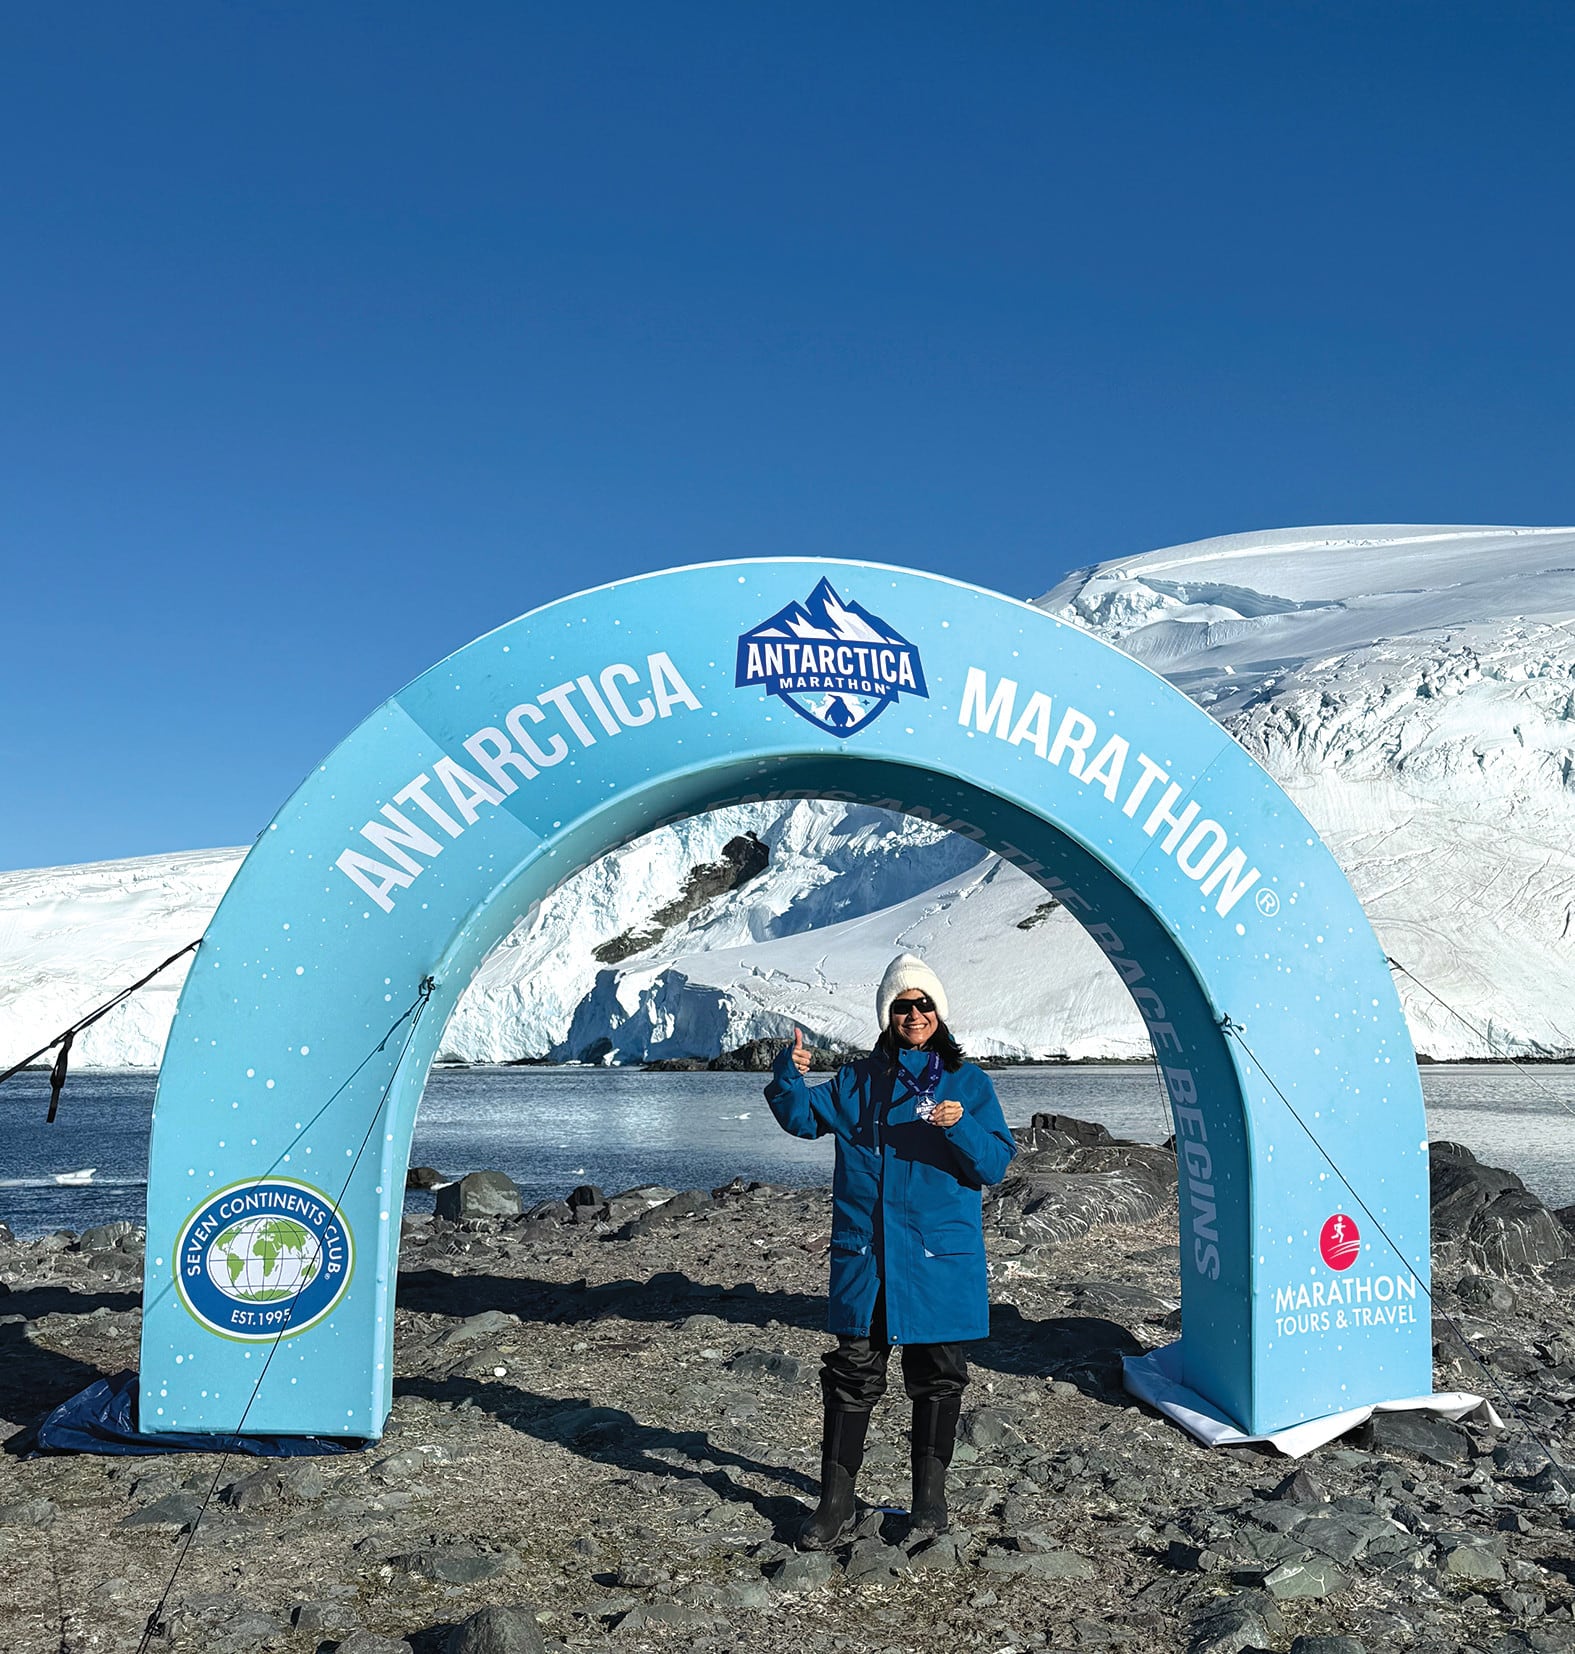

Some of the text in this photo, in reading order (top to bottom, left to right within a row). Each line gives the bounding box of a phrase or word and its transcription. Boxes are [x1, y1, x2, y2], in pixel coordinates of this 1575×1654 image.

[746, 642, 917, 689] ANTARCTICA
[335, 651, 703, 914] ANTARCTICA
[1092, 922, 1183, 1053] RACE
[1165, 1065, 1220, 1281] BEGINS
[187, 1214, 219, 1277] SEVEN
[219, 1192, 327, 1226] CONTINENTS
[1275, 1274, 1416, 1314] MARATHON
[1275, 1304, 1417, 1337] TOURS & TRAVEL
